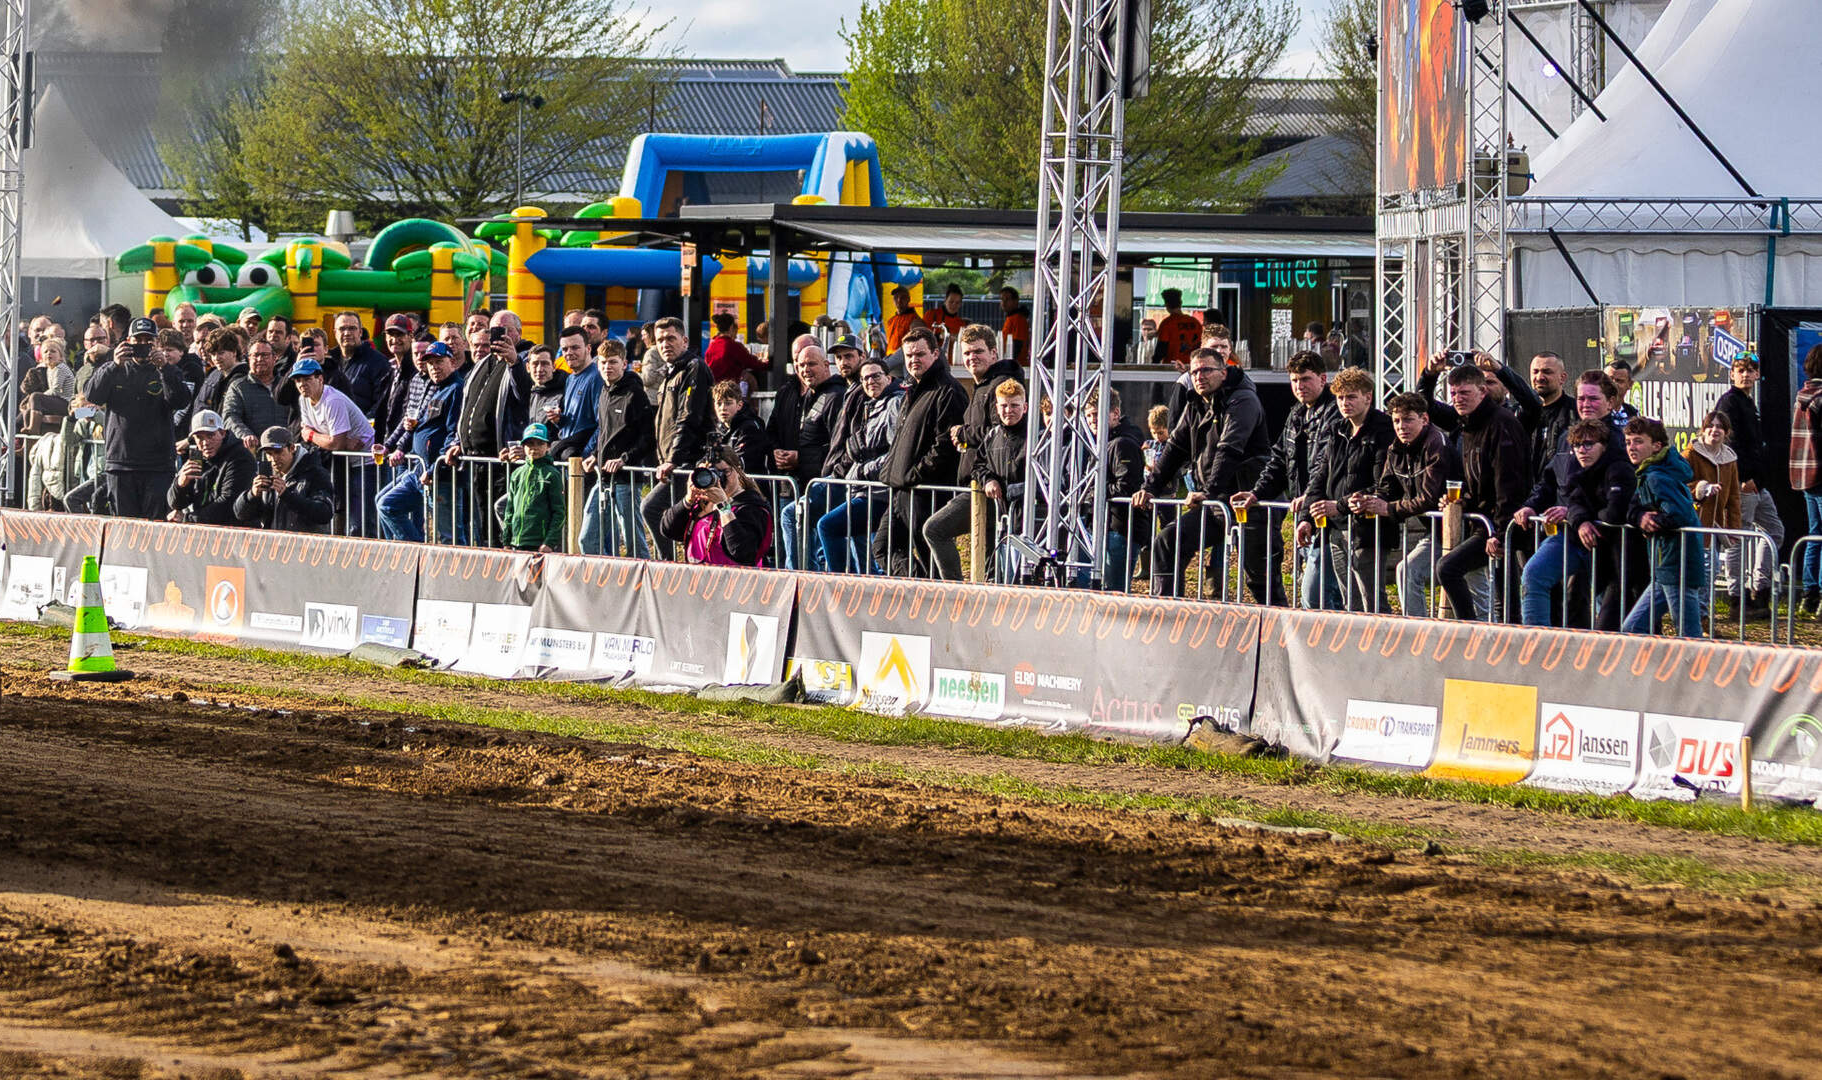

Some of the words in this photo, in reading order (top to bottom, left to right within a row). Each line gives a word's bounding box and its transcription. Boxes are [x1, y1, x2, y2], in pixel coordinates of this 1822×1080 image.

[1254, 258, 1318, 289] Entree
[1715, 335, 1739, 365] OSPE
[1662, 381, 1691, 428] GAAS
[327, 609, 352, 636] vink
[938, 676, 1000, 704] neessen
[1014, 670, 1036, 686] ELRO
[1396, 720, 1435, 738] TRANSPORT
[1578, 728, 1630, 758] Janssen
